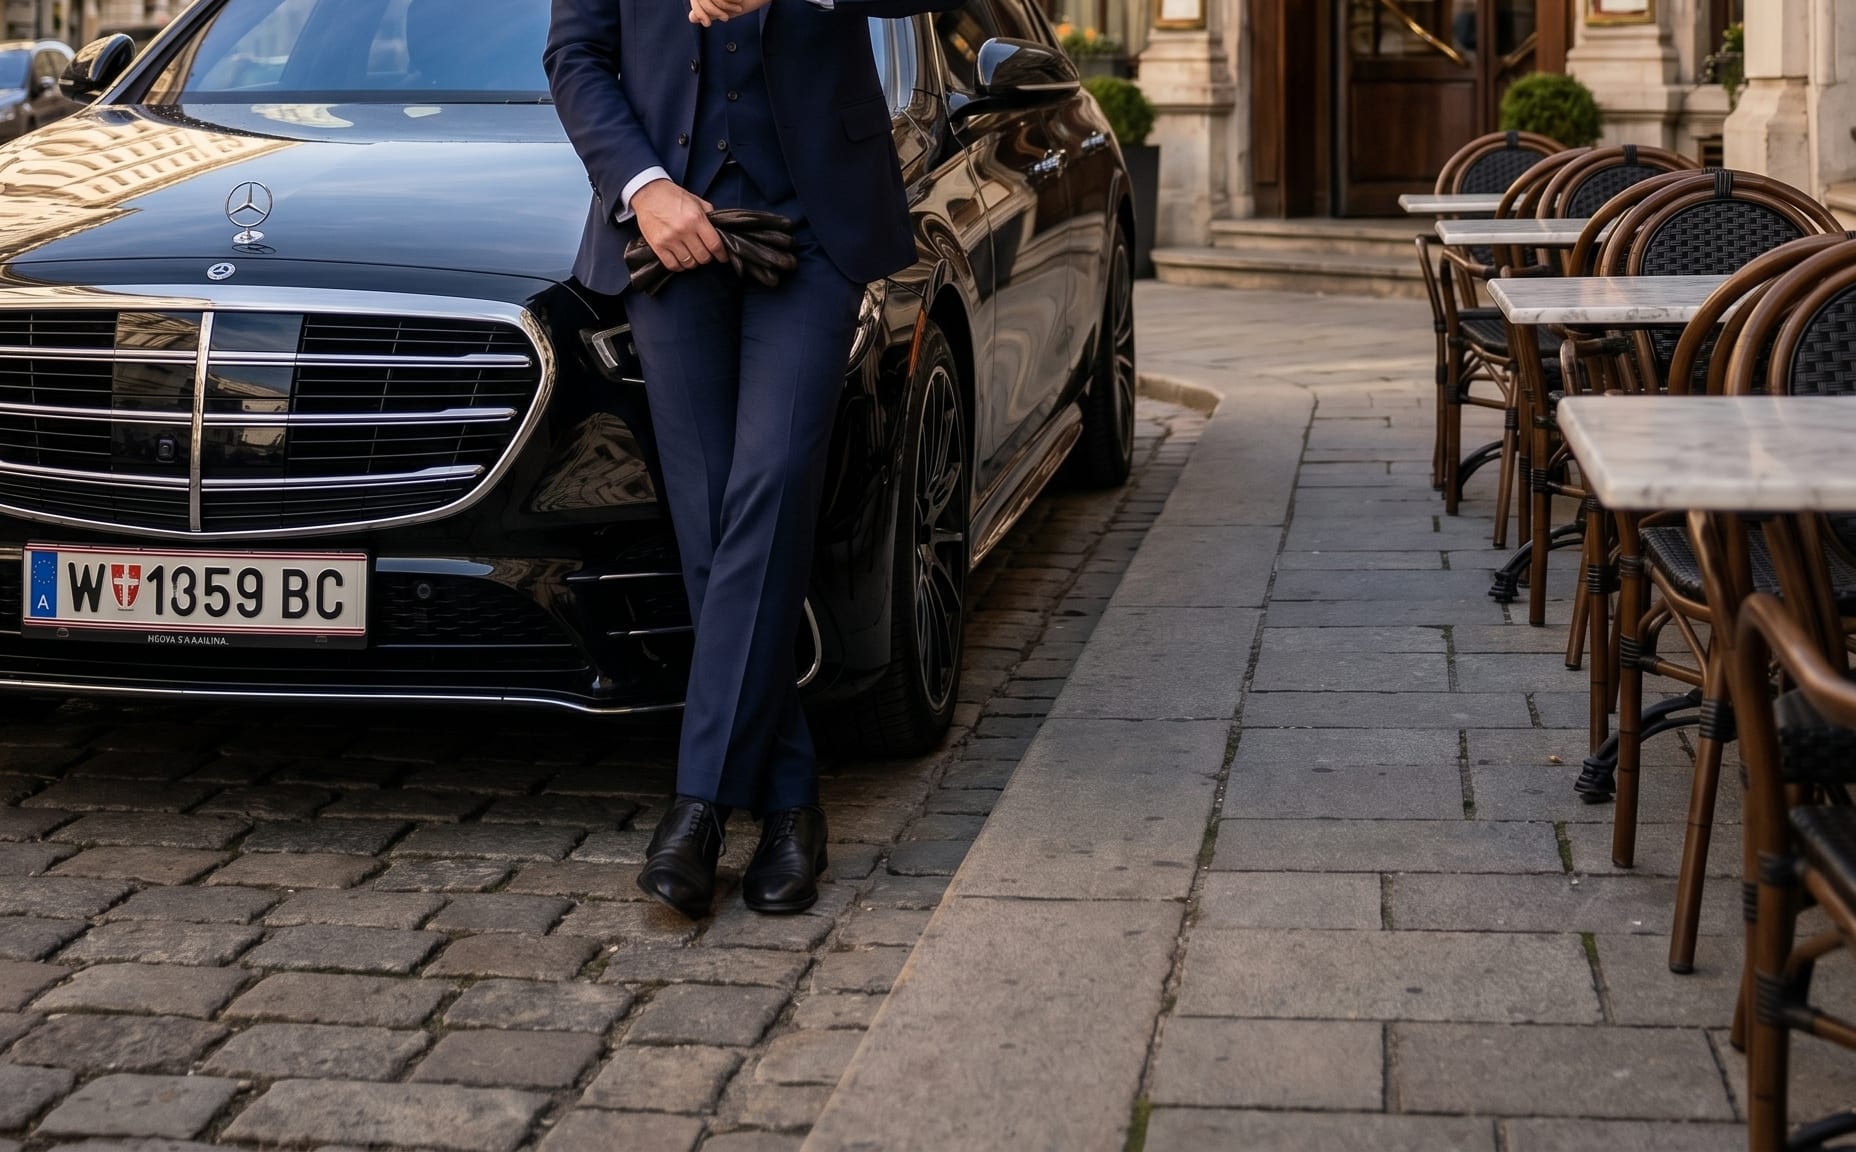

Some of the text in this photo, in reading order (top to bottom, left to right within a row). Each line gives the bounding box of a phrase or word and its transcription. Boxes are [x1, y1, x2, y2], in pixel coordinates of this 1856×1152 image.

[36, 592, 50, 611] A
[67, 561, 344, 620] W 1359 BC
